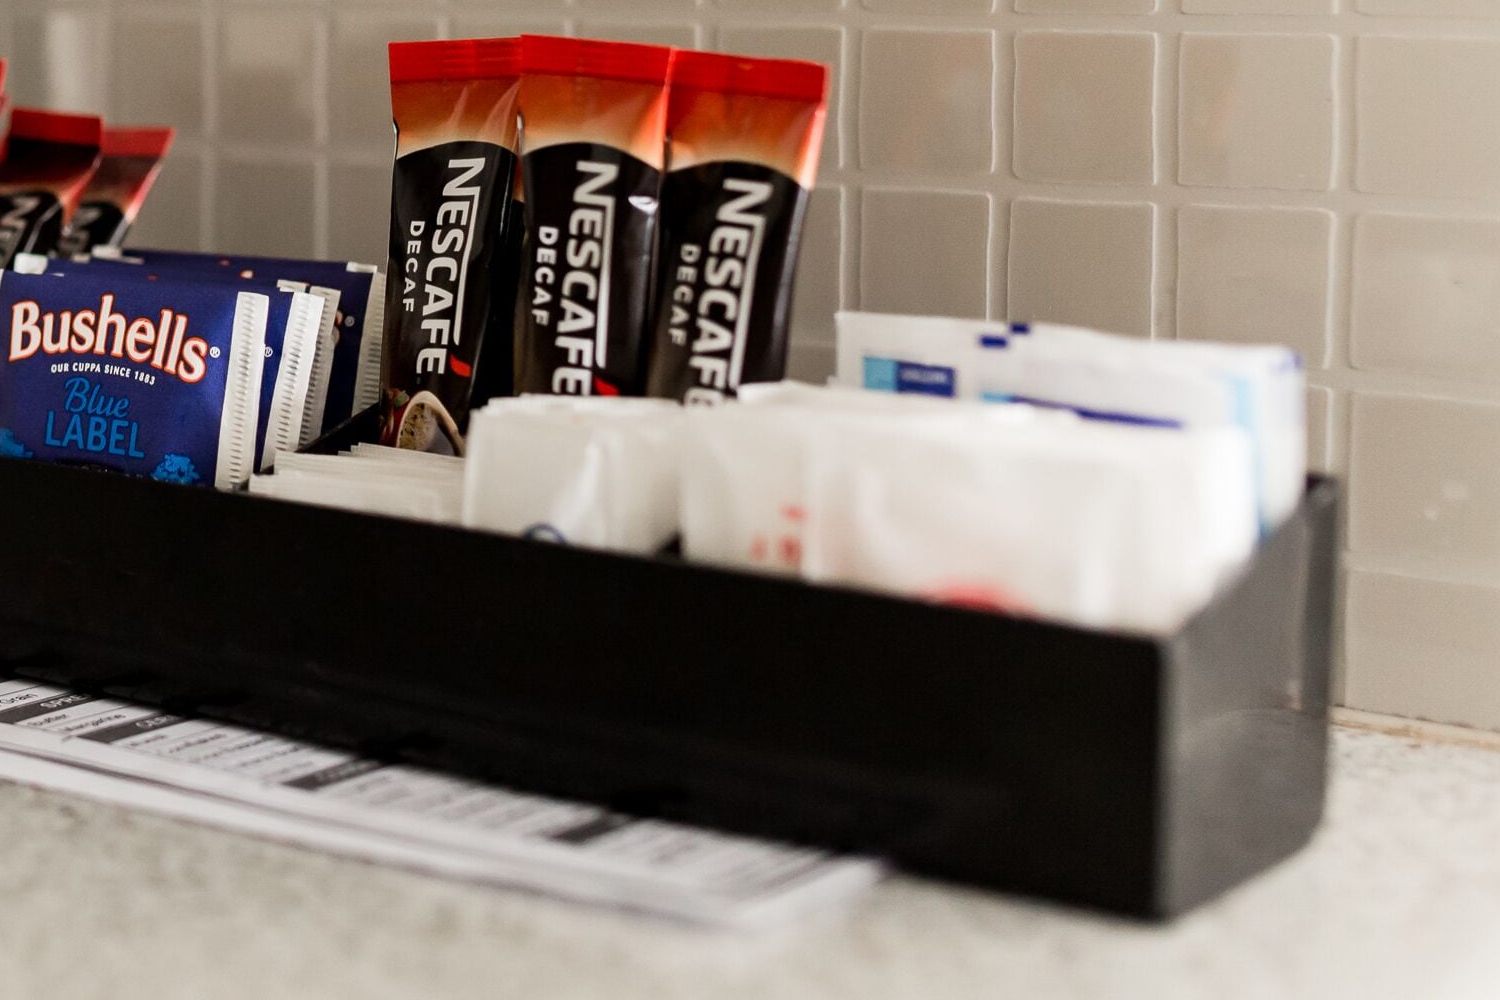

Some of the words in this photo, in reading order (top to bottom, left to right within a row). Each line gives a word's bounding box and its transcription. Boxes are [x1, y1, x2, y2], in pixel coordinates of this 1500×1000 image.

[402, 220, 425, 312] DECAF
[532, 225, 559, 327] DECAF
[668, 243, 701, 347] DECAF
[50, 363, 70, 374] OUR
[72, 362, 101, 374] CUPPA
[104, 364, 131, 378] SINCE
[134, 370, 156, 386] 1883
[64, 377, 130, 418] Blue
[44, 410, 145, 459] LABEL
